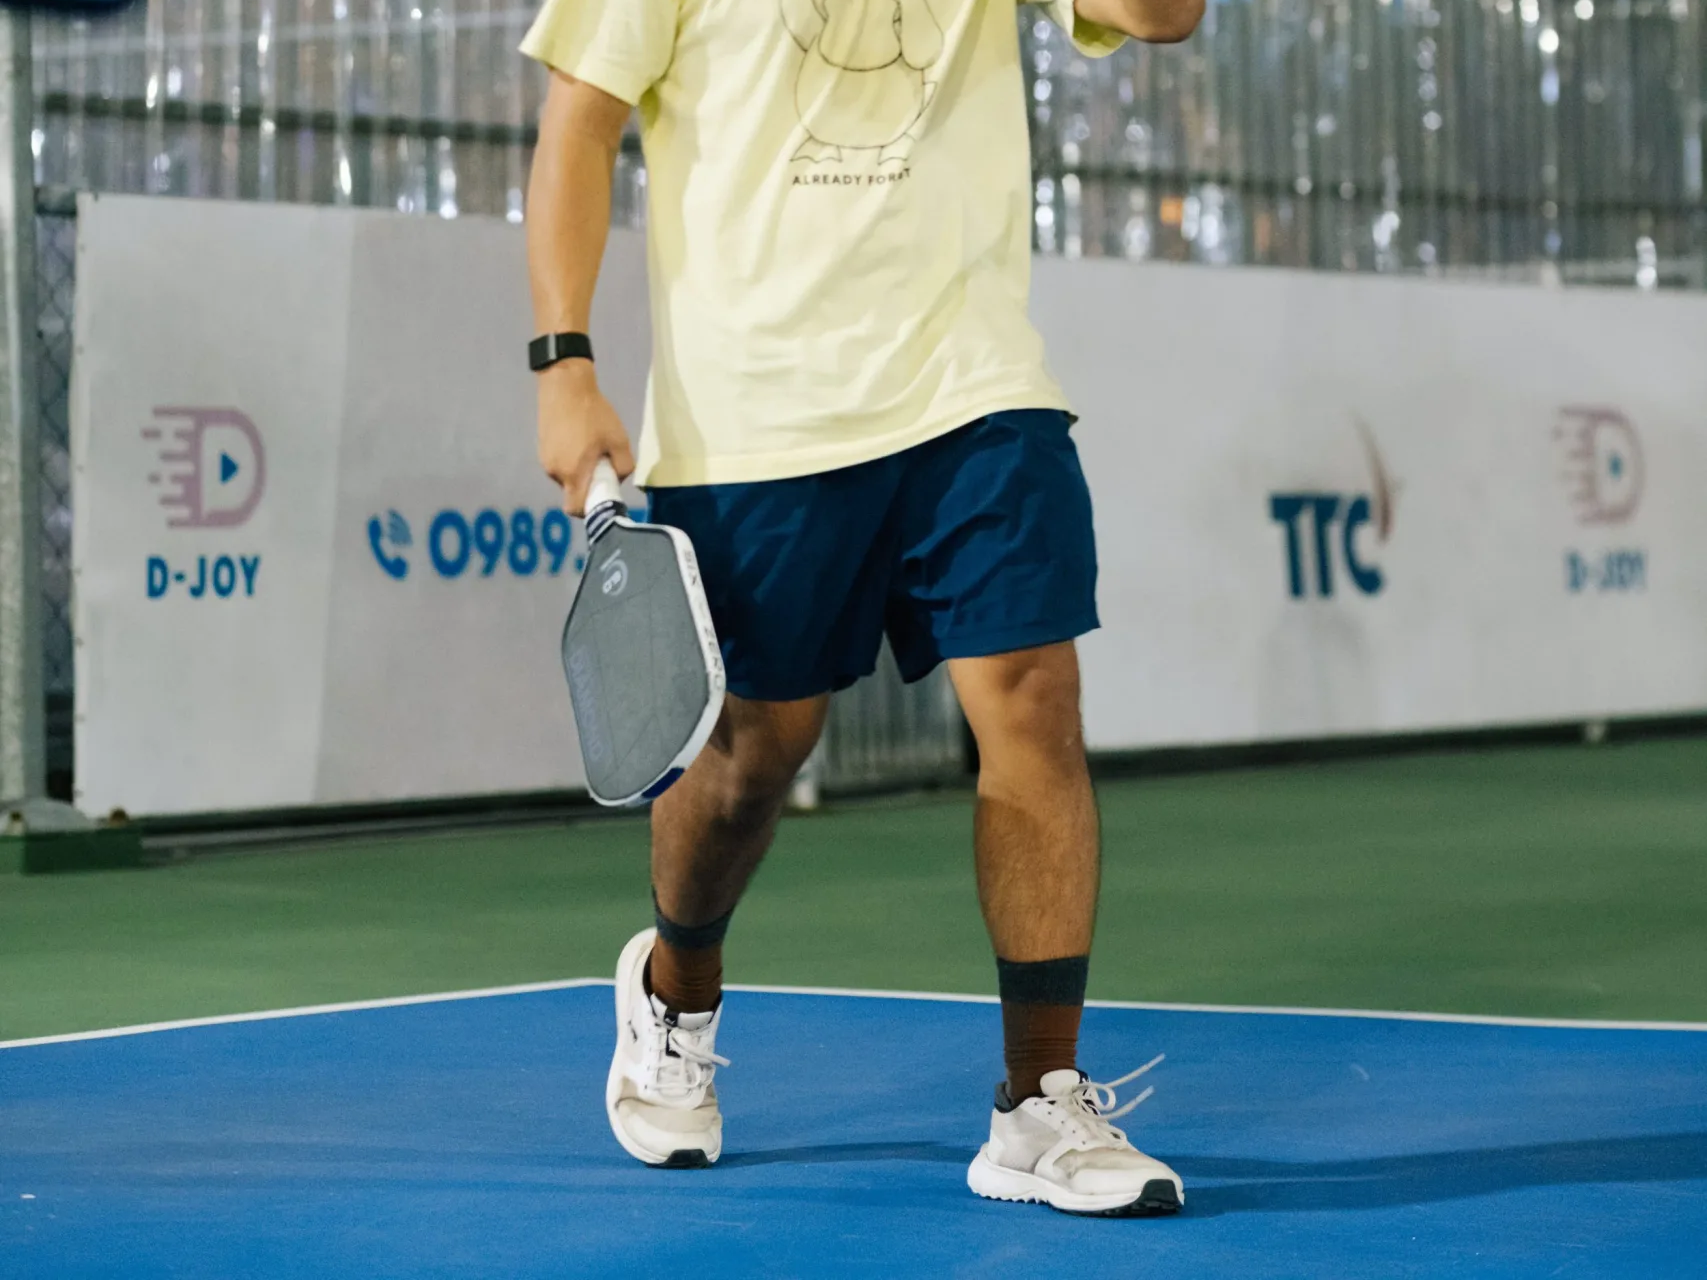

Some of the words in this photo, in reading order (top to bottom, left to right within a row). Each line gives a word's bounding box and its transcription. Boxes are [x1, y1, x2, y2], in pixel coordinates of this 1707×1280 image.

[792, 174, 862, 186] ALREADY
[1268, 493, 1386, 598] TTC
[146, 554, 262, 601] D-JOY
